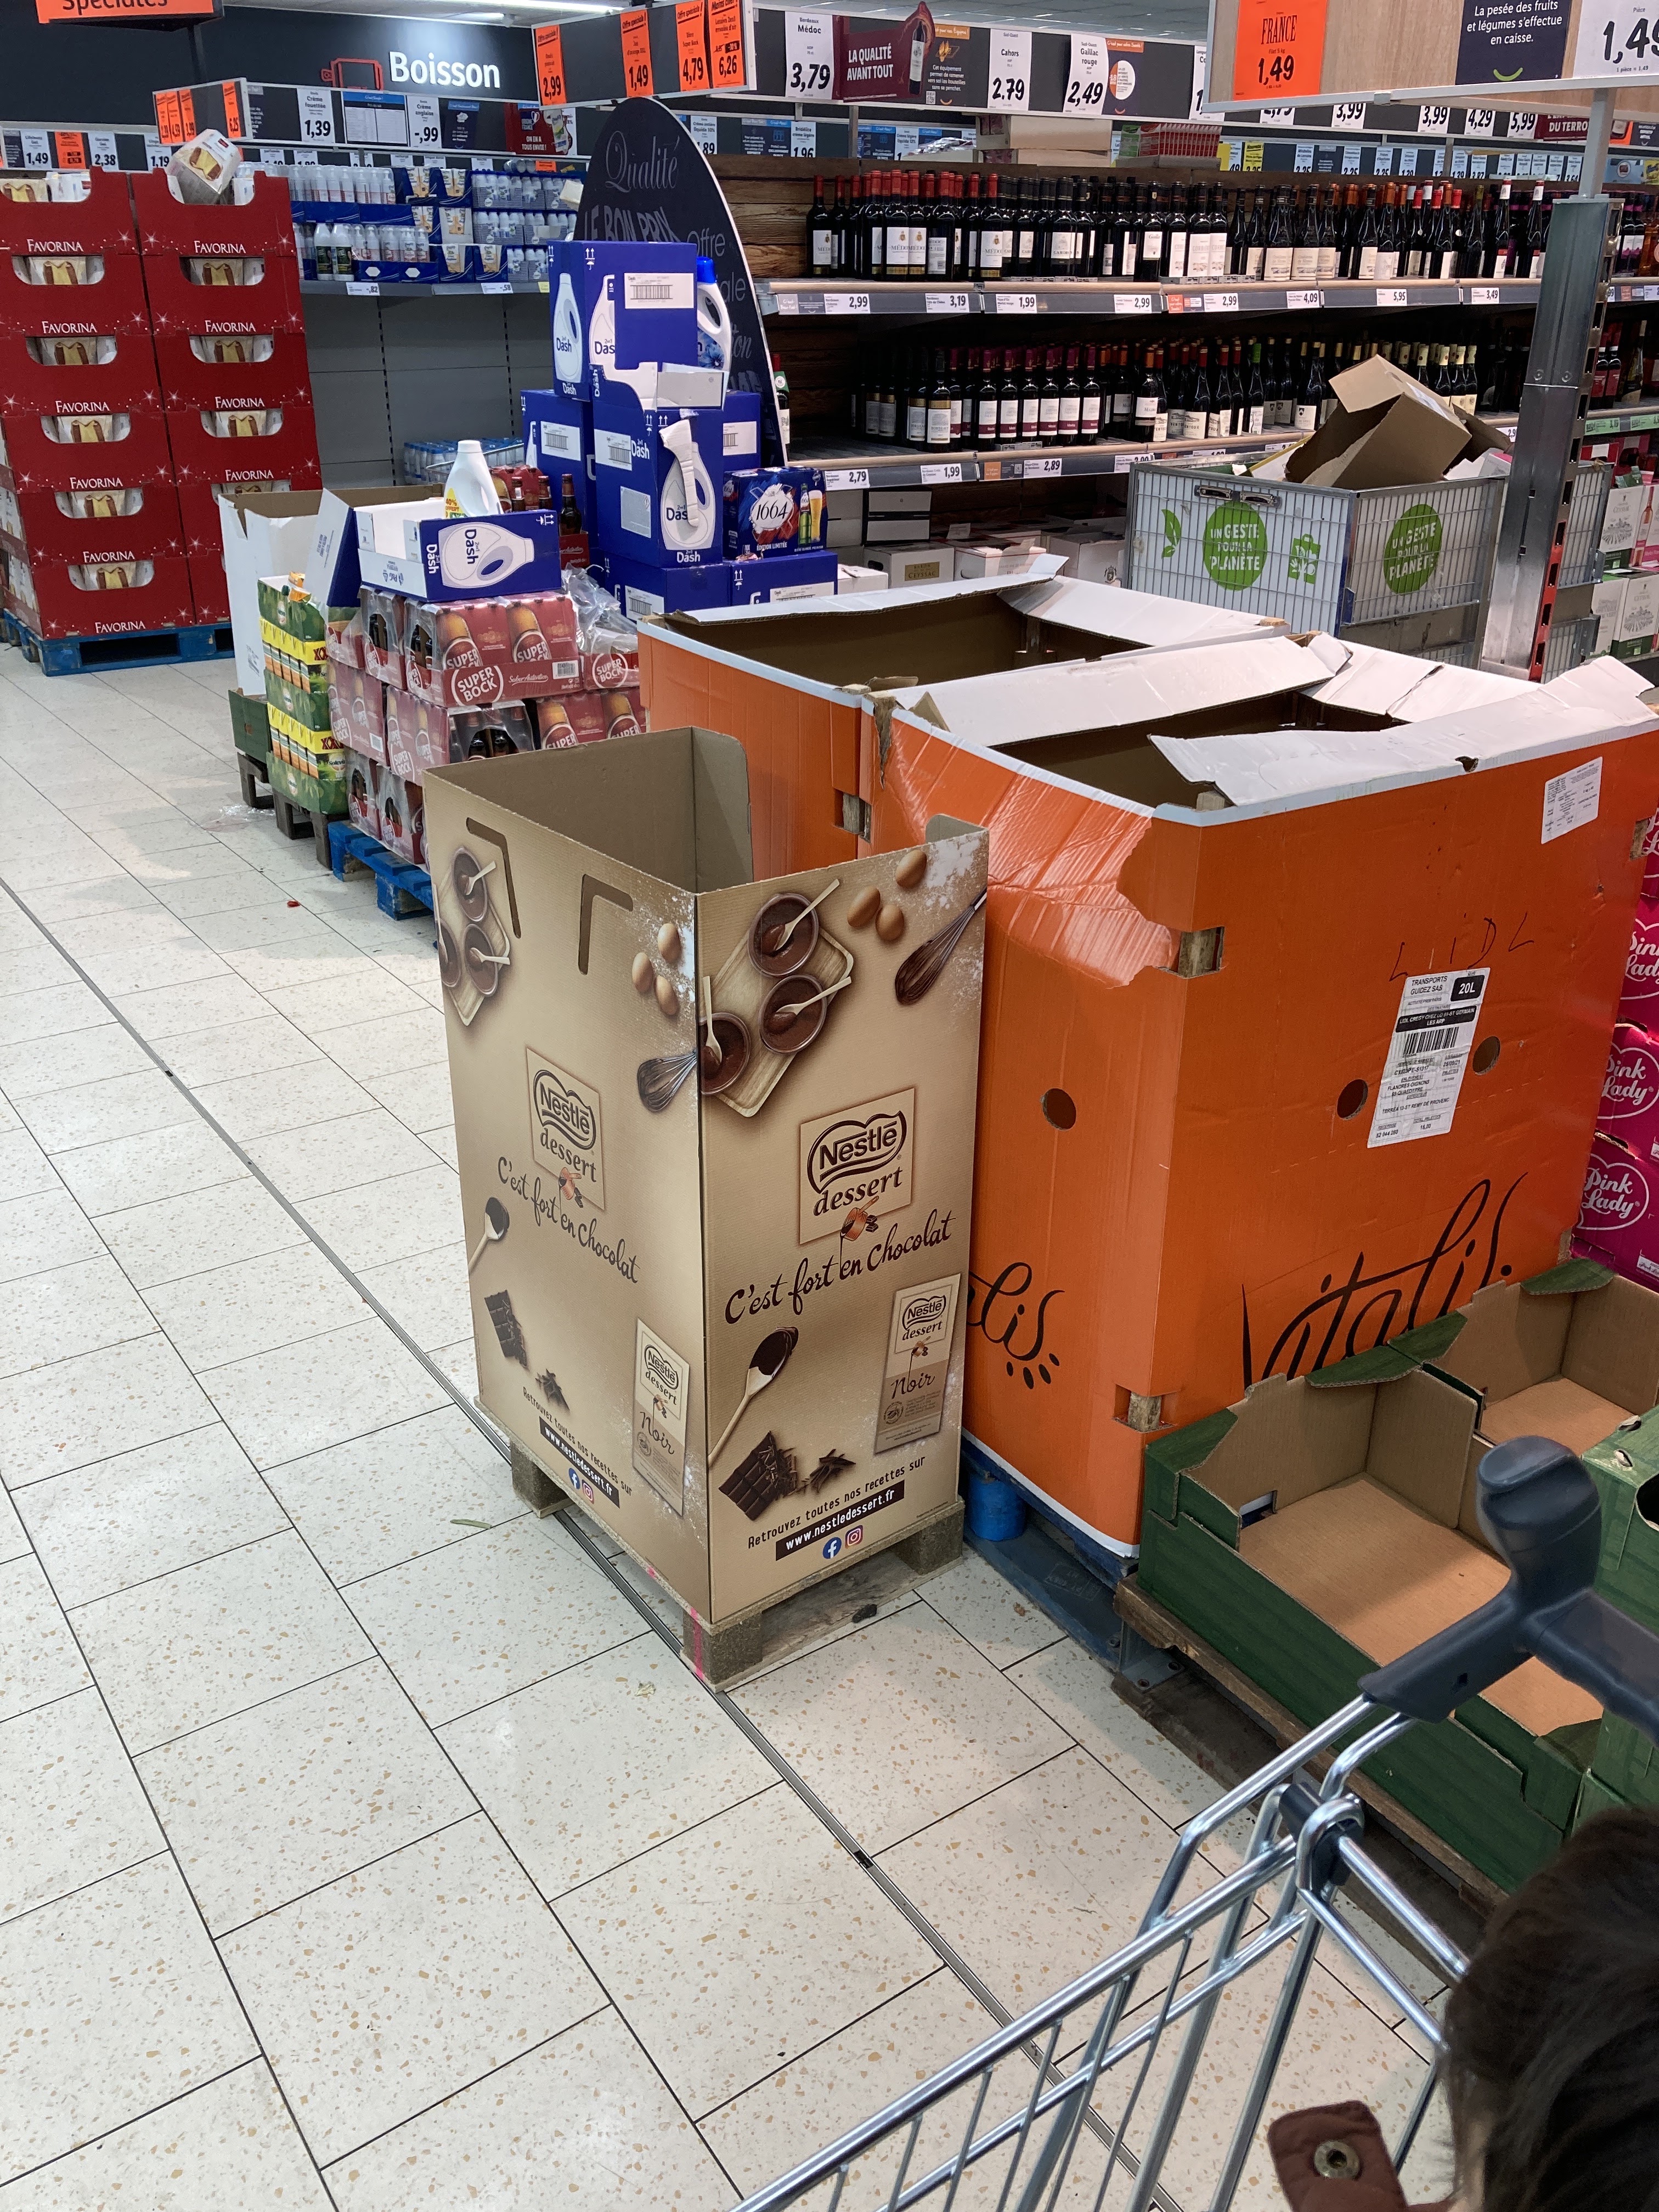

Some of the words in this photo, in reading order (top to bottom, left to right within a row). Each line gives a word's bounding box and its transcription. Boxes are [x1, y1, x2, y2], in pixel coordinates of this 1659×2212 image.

[1475, 6, 1485, 16] La
[1487, 4, 1514, 18] pesée
[1516, 2, 1532, 13] des
[1534, 0, 1558, 10] fruits
[798, 25, 822, 34] Médoc
[1261, 15, 1297, 44] FRANCE
[1467, 24, 1476, 32] et
[1478, 19, 1515, 33] légumes
[1518, 15, 1562, 30] s'effectue
[1491, 37, 1502, 45] en
[1504, 33, 1533, 44] caisse.
[848, 50, 857, 63] LA
[859, 43, 892, 61] QUALITÉ
[1001, 48, 1019, 57] Cahors
[1080, 48, 1099, 56] Gaillac
[389, 51, 501, 89] Boisson
[682, 57, 704, 85] 4,79
[718, 54, 737, 78] 6,26
[847, 66, 872, 81] AVANT
[873, 64, 894, 78] TOUT
[1258, 54, 1295, 86] 1,49
[629, 65, 648, 92] 1,49
[790, 62, 831, 93] 3,79
[543, 75, 562, 100] 2,99
[1067, 81, 1103, 107] 2,49
[1336, 103, 1364, 122] 3,99
[1423, 106, 1448, 127] 3,99
[1468, 109, 1493, 129] 4,29
[304, 119, 331, 138] 1,39
[1510, 112, 1536, 133] 5,99
[1549, 122, 1561, 132] DU
[1562, 121, 1588, 132] TERRO
[414, 126, 438, 144] -,99
[26, 152, 48, 166] 1,49
[94, 154, 116, 166] 2,38
[605, 130, 680, 193] Qualité
[27, 239, 83, 252] FAVORINA
[194, 240, 246, 254] FAVORINA
[687, 227, 726, 257] Offre
[849, 295, 868, 308] 2,99
[950, 295, 966, 308] 3,19
[1018, 296, 1035, 308] 1,99
[1135, 297, 1150, 308] 2,99
[1222, 296, 1237, 306] 2,99
[1303, 292, 1318, 304] 4,09
[1393, 291, 1406, 302] 5,95
[1486, 290, 1498, 300] 3,49
[42, 321, 97, 334] FAVORINA
[205, 320, 256, 333] FAVORINA
[556, 337, 572, 353] Dash
[594, 341, 616, 355] Das
[562, 382, 577, 396] Dash
[55, 400, 109, 413] FAVORINA
[215, 396, 264, 409] FAVORINA
[631, 441, 650, 460] Dash
[943, 466, 960, 478] 1,99
[1043, 459, 1060, 472] 2,89
[70, 477, 122, 489] FAVORINA
[225, 470, 274, 481] FAVORINA
[849, 471, 867, 484] 2,79
[666, 507, 688, 521] Das
[756, 500, 788, 521] 1664
[1224, 523, 1260, 539] GESTE
[1406, 522, 1436, 545] GESTE
[465, 528, 479, 565] Dash
[1242, 541, 1252, 552] LA
[83, 551, 135, 563] FAVORINA
[426, 544, 439, 574] Dash
[676, 551, 701, 563] Dash
[1209, 552, 1260, 571] PLANÈTE
[95, 620, 146, 634] FAVORINA
[447, 649, 480, 669] SUPER
[517, 643, 548, 663] SUPER
[596, 658, 622, 675] SUPER
[600, 667, 624, 682] BOCK
[457, 667, 494, 693] SUPER
[462, 679, 498, 703] BOCK
[1410, 986, 1431, 995] GUIDEZ
[1412, 975, 1448, 986] TRANSPORTS
[1458, 981, 1476, 995] 20L
[1601, 1075, 1648, 1105] Lady
[540, 1082, 591, 1135] Nestlé
[540, 1127, 597, 1183] dessert
[819, 1120, 898, 1171] Nestlé
[1583, 1167, 1633, 1195] Pink
[813, 1166, 903, 1216] dessert
[1581, 1188, 1635, 1219] Lady
[498, 1156, 529, 1200] C'est
[531, 1177, 559, 1226] fort
[560, 1211, 576, 1238] en
[578, 1218, 640, 1284] Chocolat
[725, 1273, 794, 1324] C'est
[788, 1255, 838, 1316] fort
[839, 1256, 864, 1281] en
[867, 1208, 956, 1272] Chocolat
[906, 1297, 943, 1320] Nestlé
[902, 1319, 943, 1341] dessert
[648, 1350, 676, 1383] Nestlé
[645, 1370, 677, 1406] dessert
[891, 1372, 936, 1399] Noir
[522, 1386, 554, 1424] Retrouvez
[554, 1417, 575, 1444] toutes
[577, 1440, 589, 1457] nos
[590, 1452, 618, 1484] recettes
[620, 1480, 633, 1496] sur
[640, 1411, 675, 1455] Noir
[545, 1426, 613, 1496] www.nestledessert.fr
[748, 1515, 802, 1550] Retrouvez
[805, 1499, 841, 1522] toutes
[844, 1487, 861, 1503] nos
[865, 1467, 906, 1492] recettes
[909, 1455, 926, 1474] sur
[785, 1487, 895, 1551] www.nestledessert.fr
